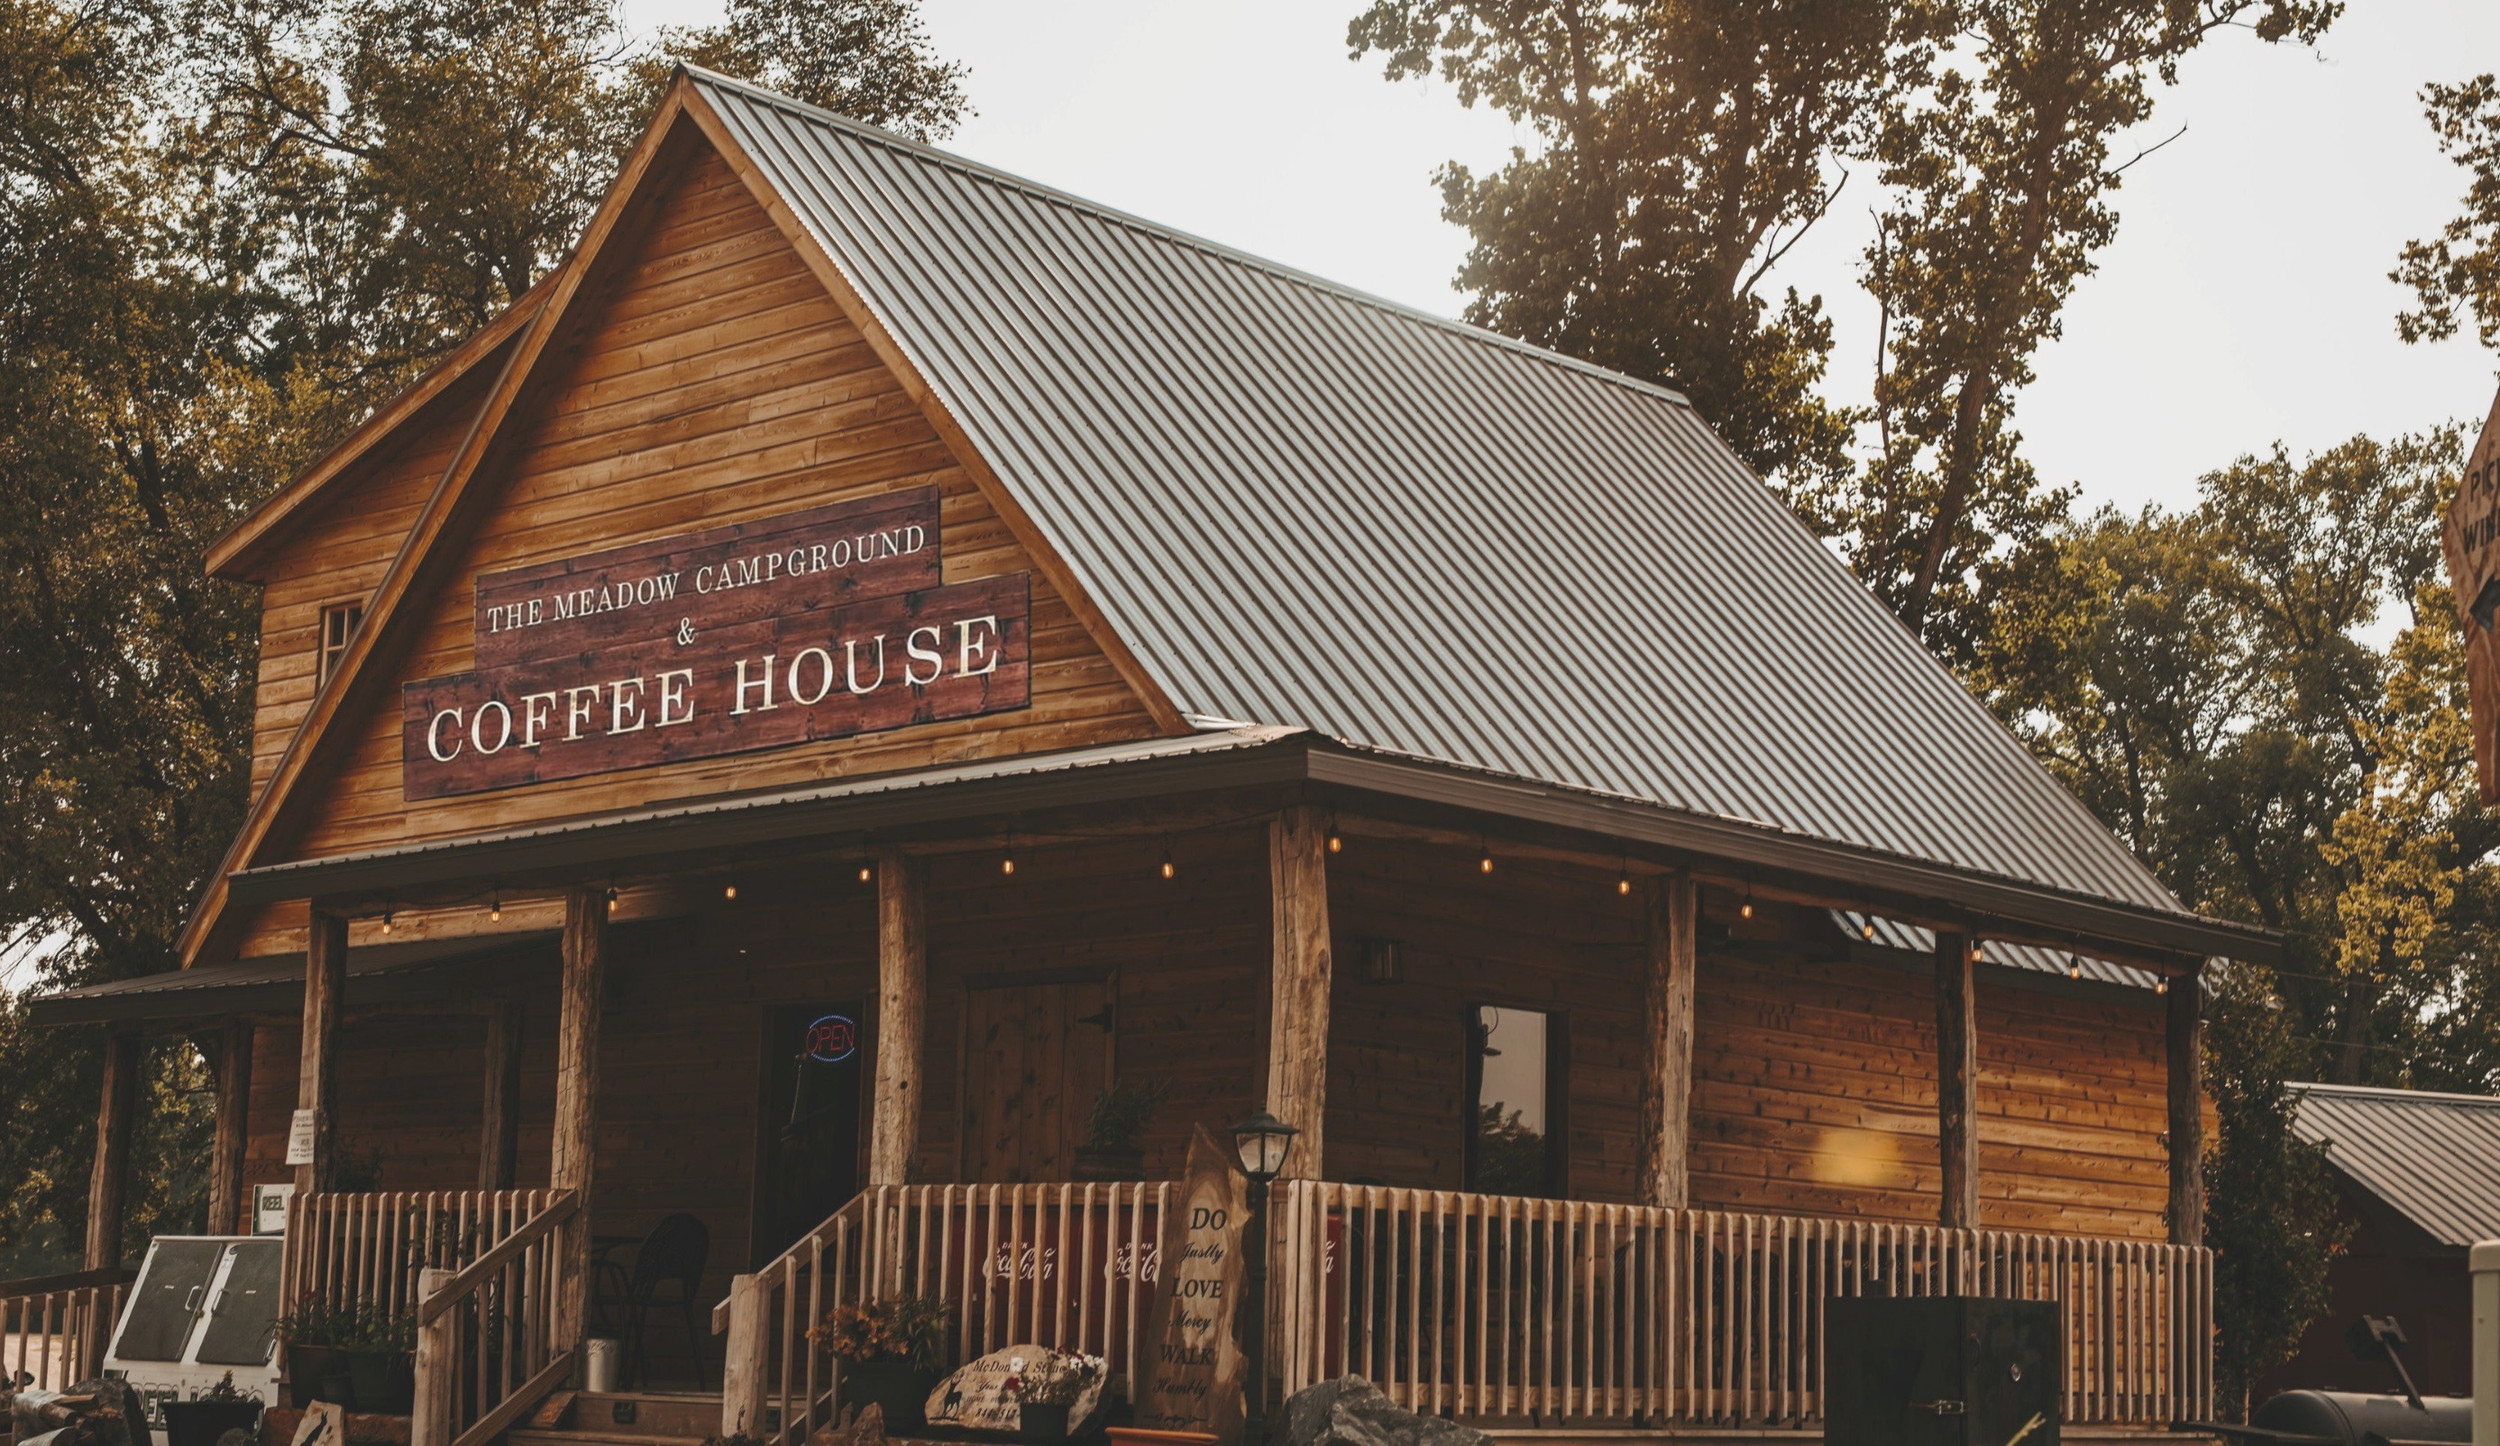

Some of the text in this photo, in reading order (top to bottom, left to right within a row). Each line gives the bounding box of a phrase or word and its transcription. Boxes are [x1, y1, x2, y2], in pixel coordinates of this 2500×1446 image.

[487, 524, 926, 634] THE MEADOW CAMPGROUND
[676, 616, 697, 645] &
[427, 614, 998, 762] COFFEE HOUSE
[806, 1024, 855, 1053] OPEN
[1190, 1207, 1227, 1231] DO
[1180, 1242, 1224, 1265] Justly
[1170, 1278, 1224, 1298] LOVE
[1168, 1310, 1212, 1335] Mercy
[973, 1360, 1029, 1373] McDond
[1160, 1344, 1215, 1365] WALK
[1153, 1378, 1207, 1401] Humbly
